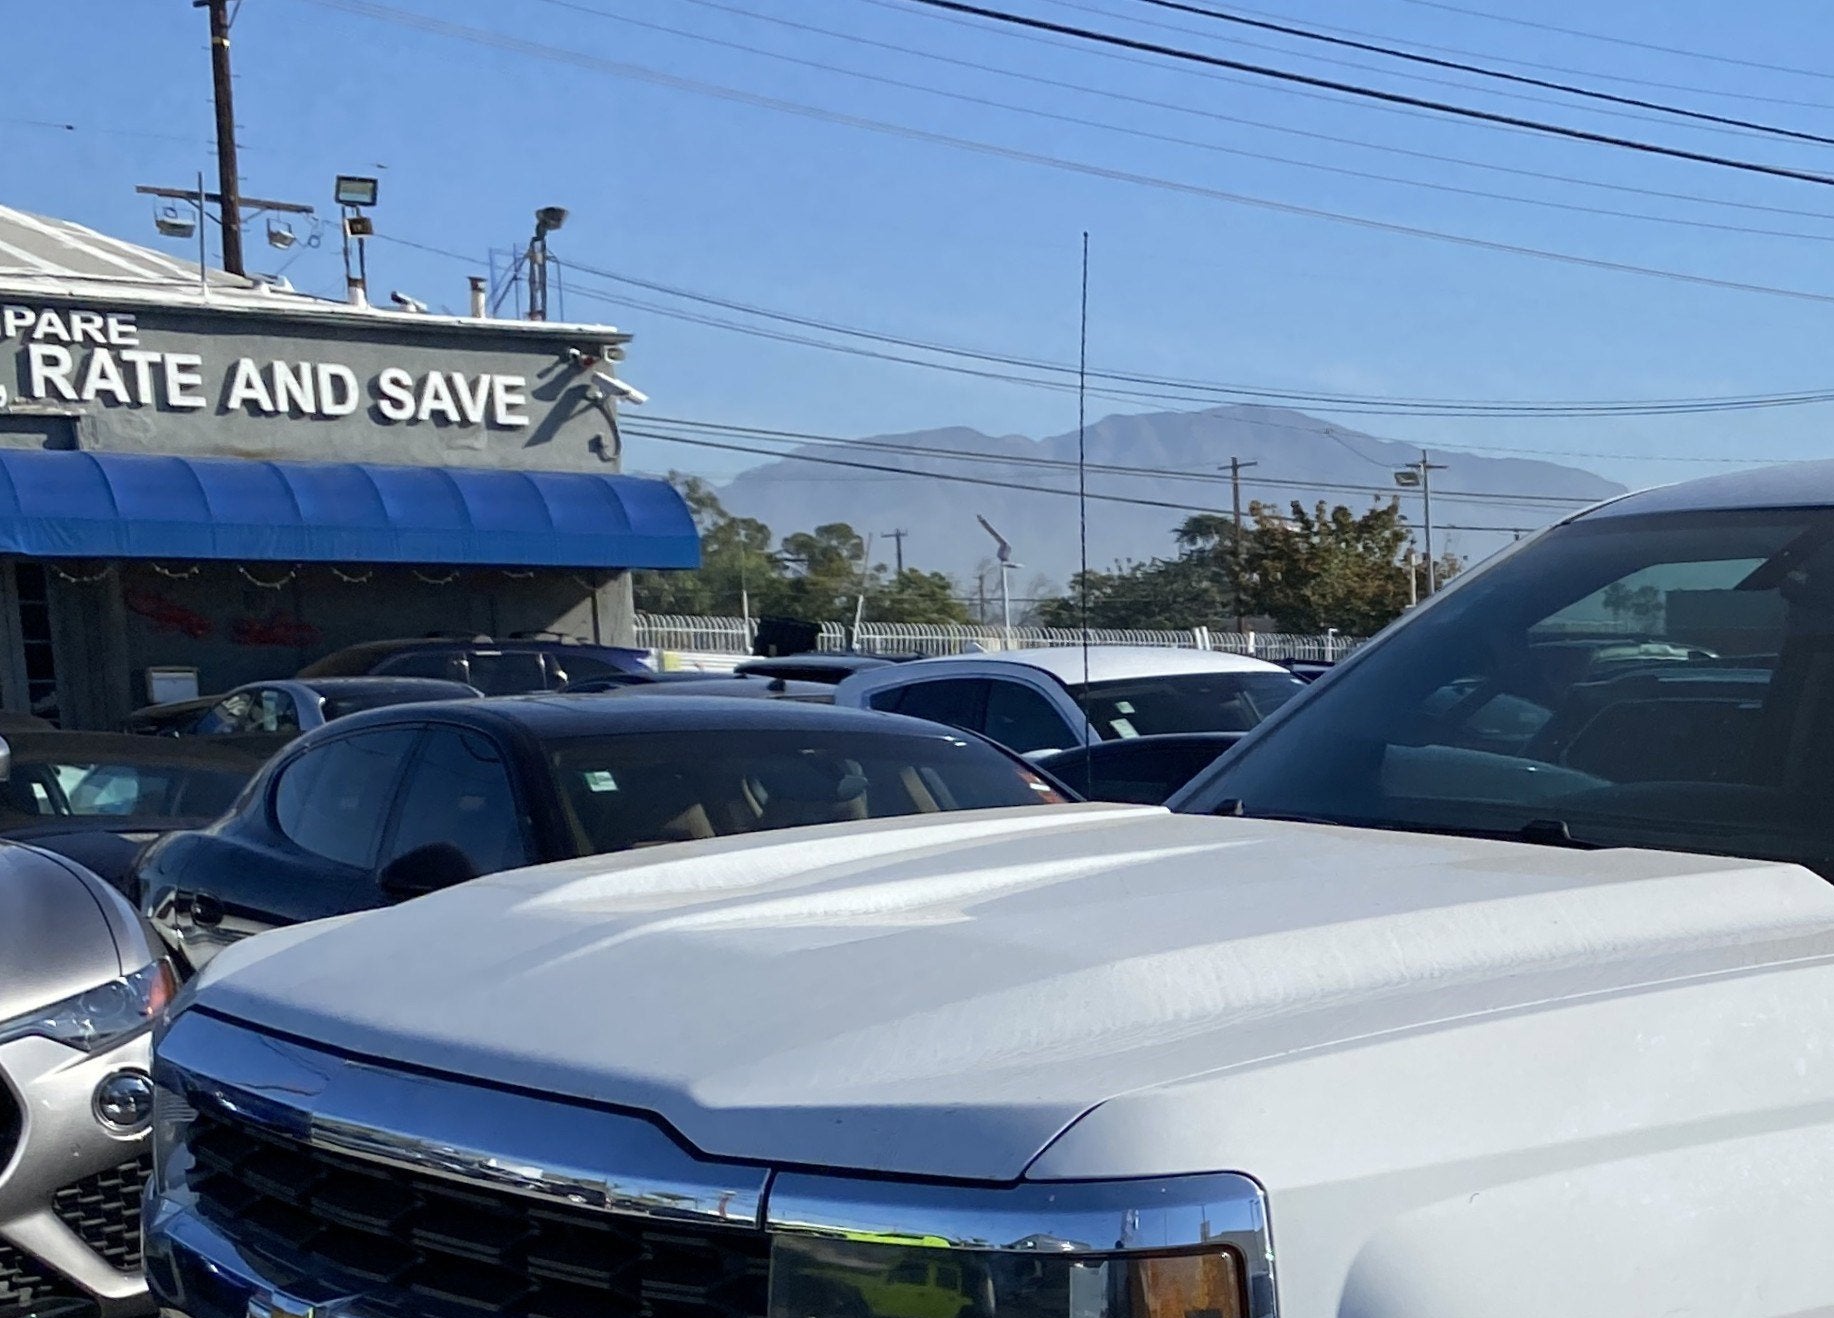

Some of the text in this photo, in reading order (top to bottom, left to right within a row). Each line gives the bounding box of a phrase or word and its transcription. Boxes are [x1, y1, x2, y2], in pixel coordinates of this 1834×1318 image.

[0, 305, 139, 345] PARE
[29, 343, 530, 425] RATE AND SAVE
